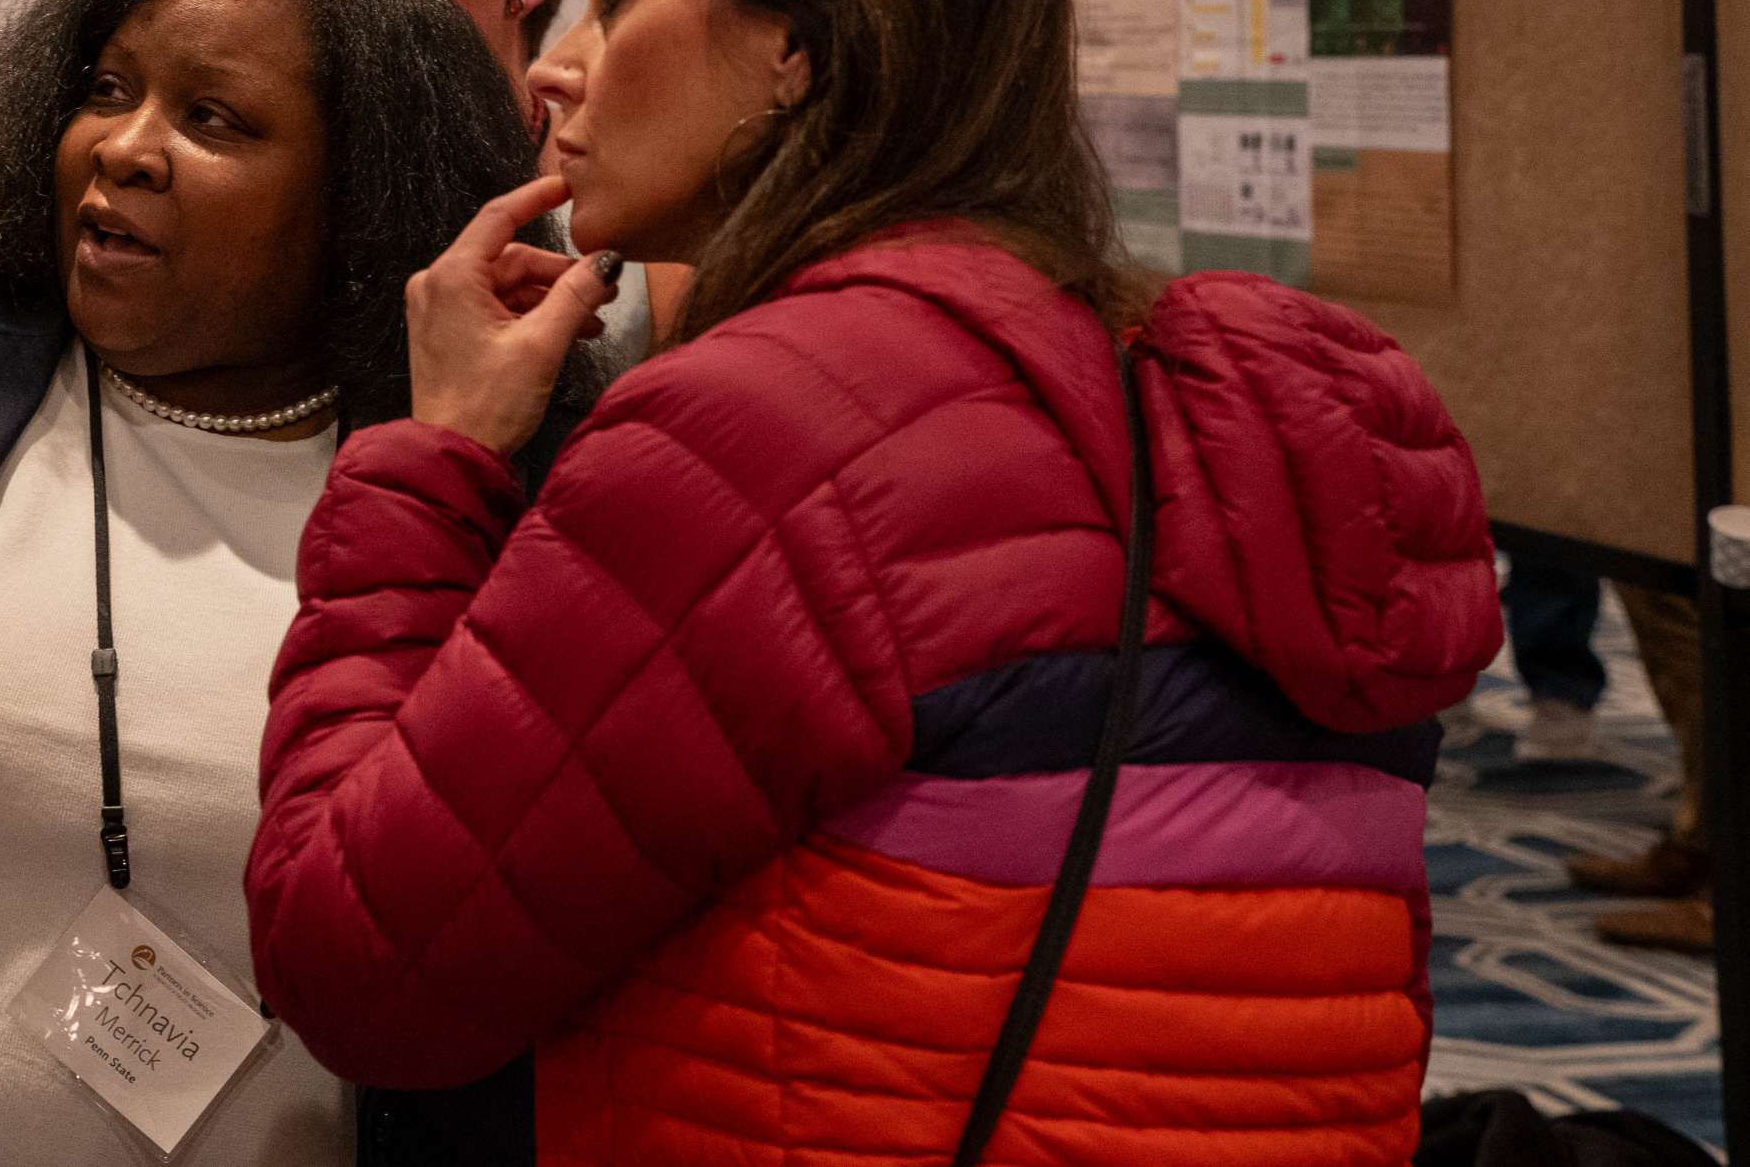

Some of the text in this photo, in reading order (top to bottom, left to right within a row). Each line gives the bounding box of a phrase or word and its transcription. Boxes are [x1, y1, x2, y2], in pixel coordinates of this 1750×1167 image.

[95, 1006, 162, 1071] Merrick
[102, 960, 200, 1061] Tchnavia
[85, 1036, 136, 1084] Penn State
